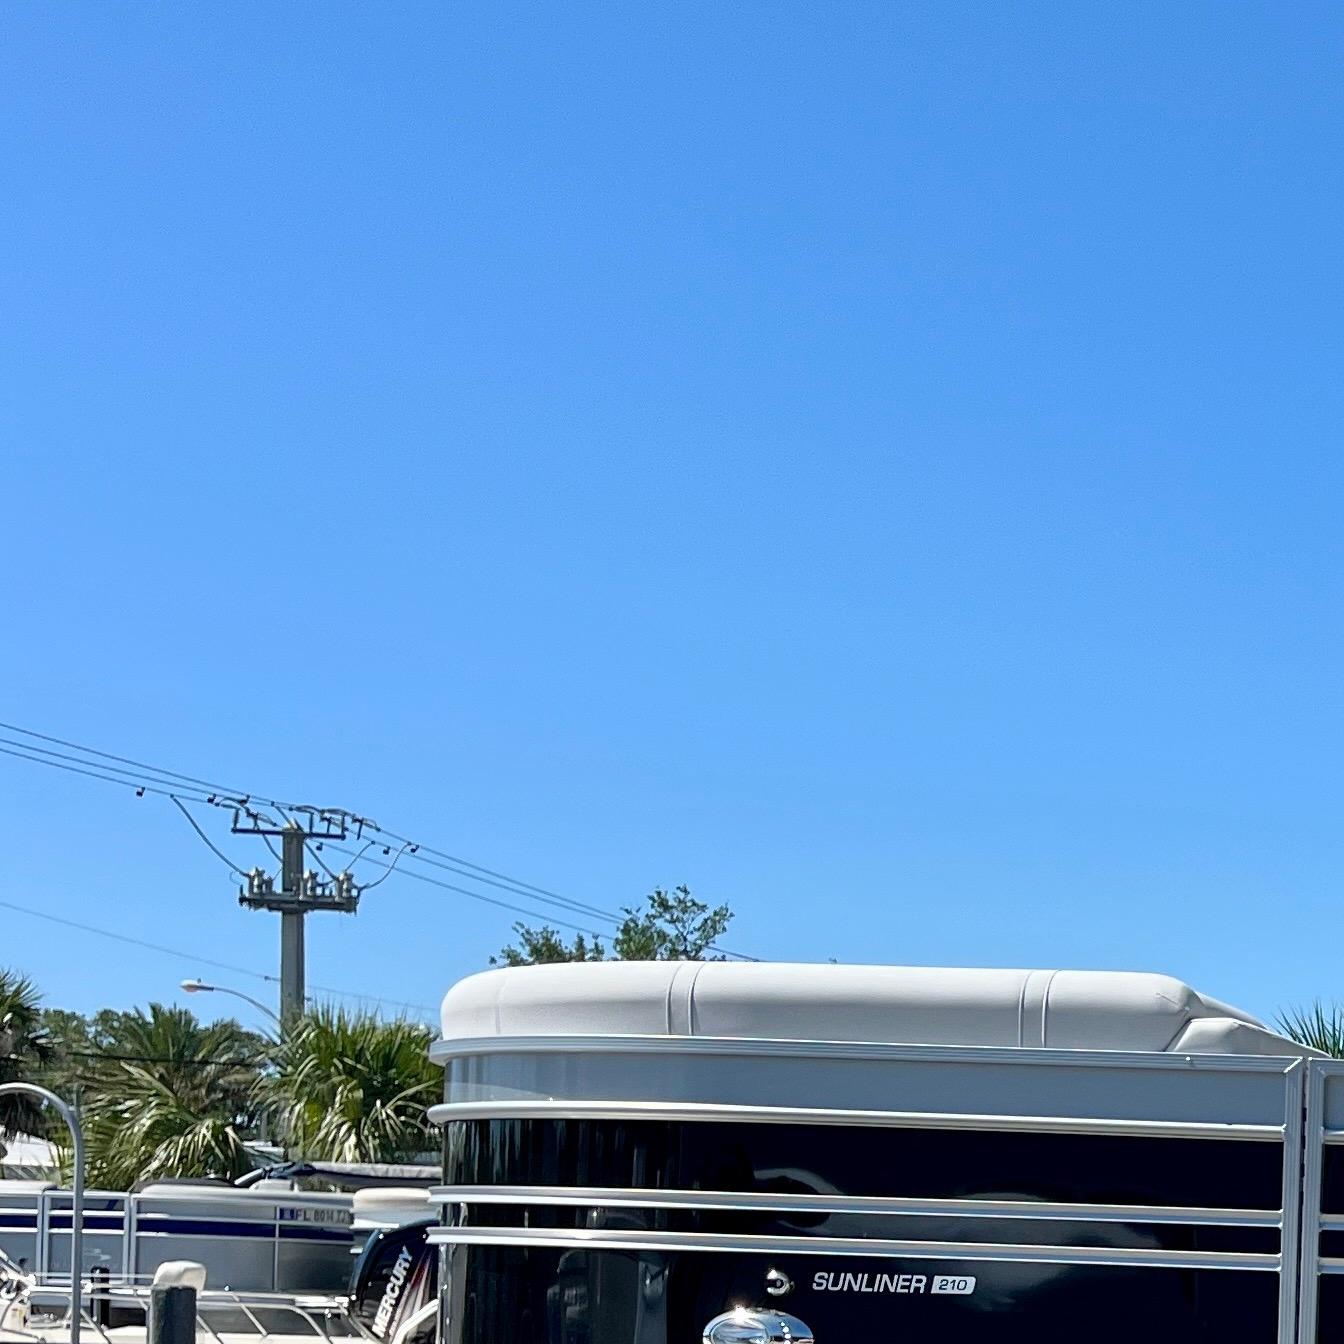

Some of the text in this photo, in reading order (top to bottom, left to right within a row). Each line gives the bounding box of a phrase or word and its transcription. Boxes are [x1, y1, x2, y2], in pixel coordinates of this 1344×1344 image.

[372, 1245, 412, 1338] MERCURY
[812, 1272, 968, 1294] SUNLINER 210
